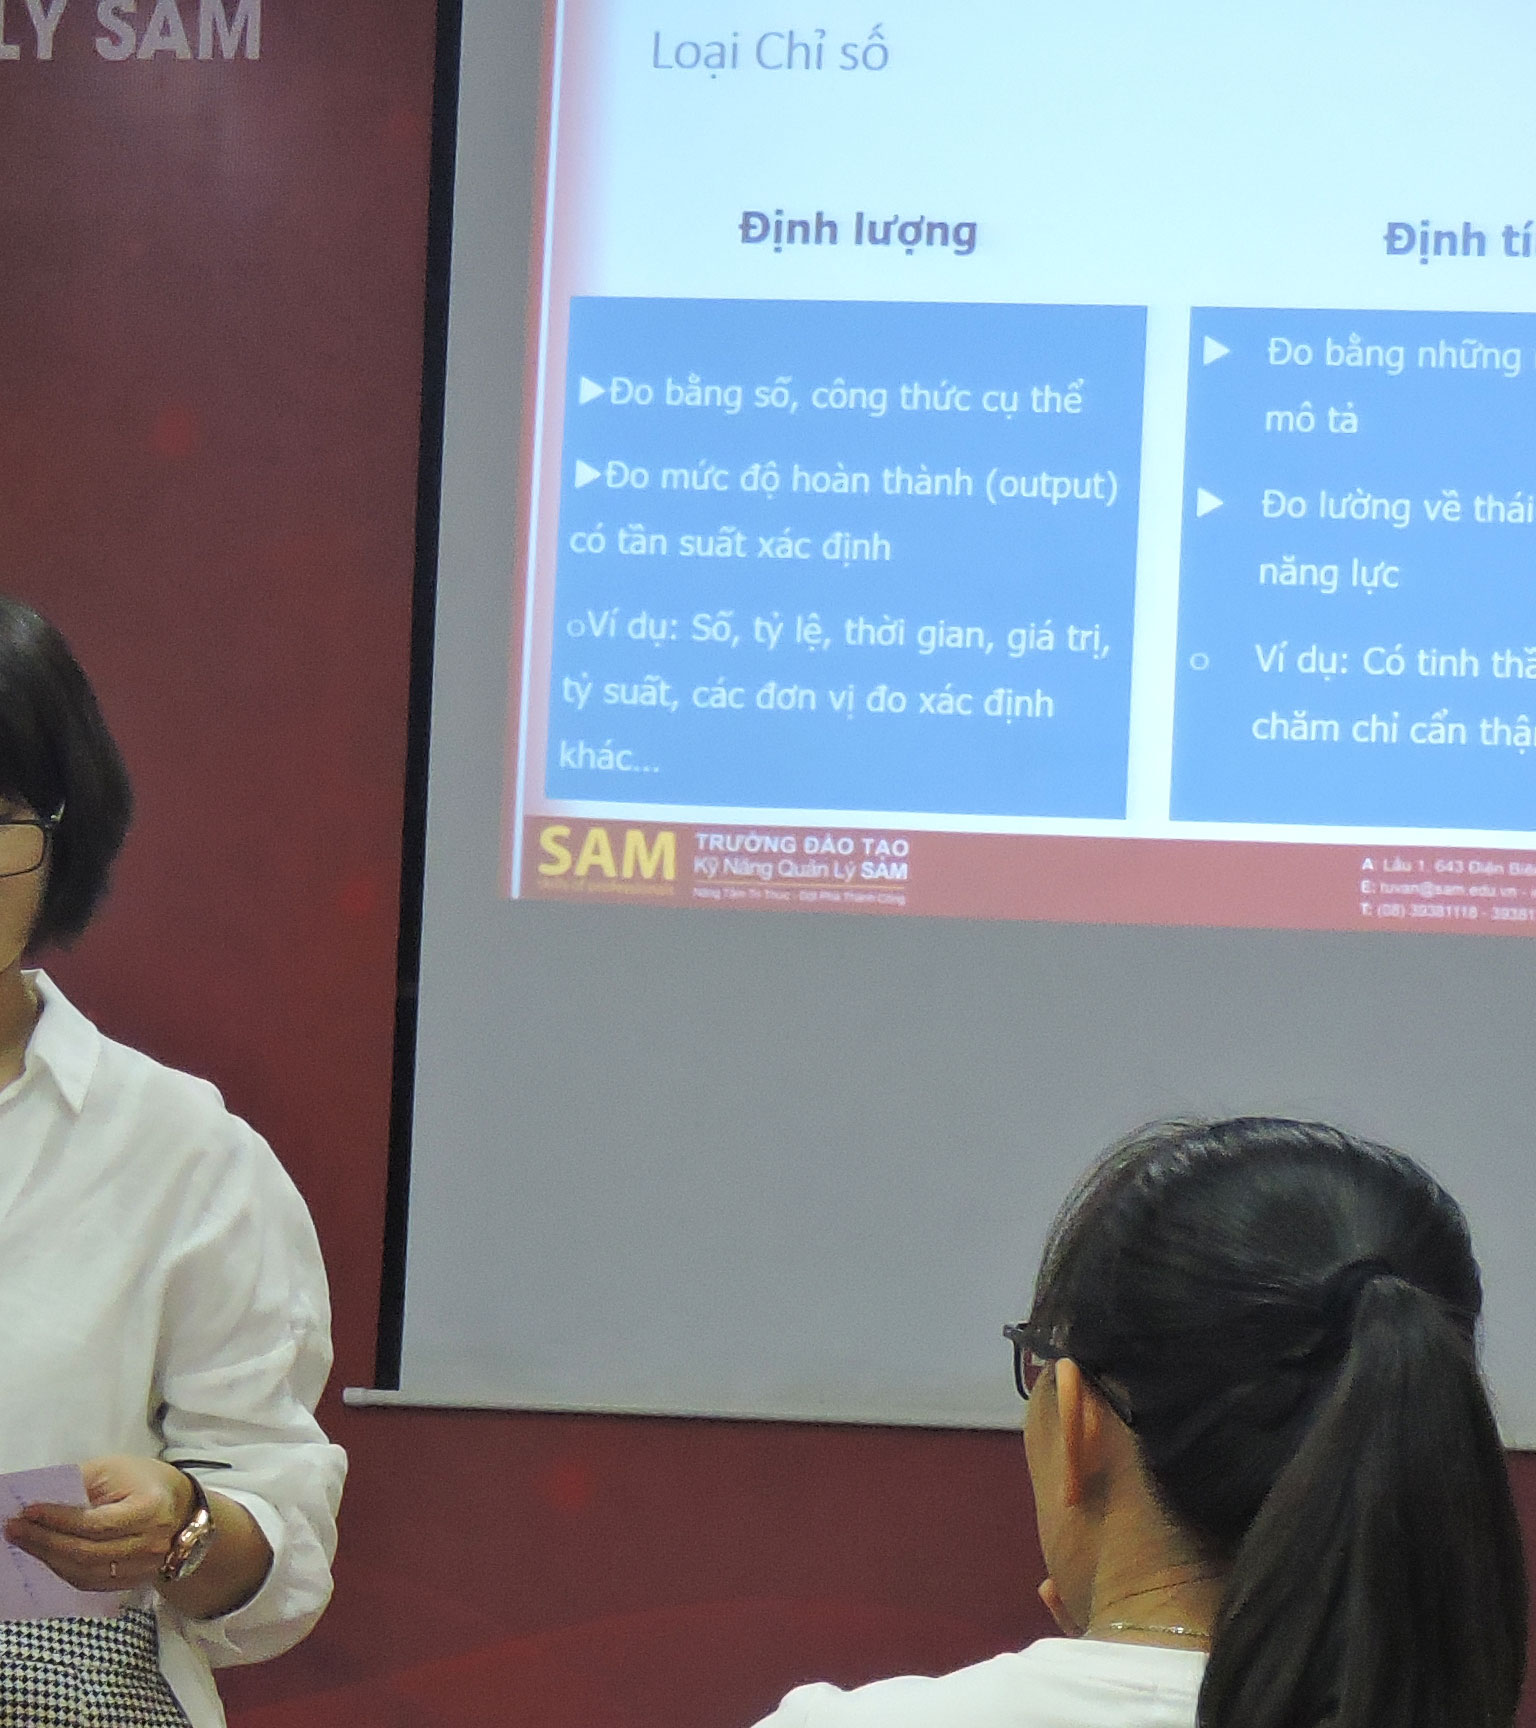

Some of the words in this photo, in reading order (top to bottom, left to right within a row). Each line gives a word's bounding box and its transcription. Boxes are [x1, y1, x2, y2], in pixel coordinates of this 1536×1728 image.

[94, 0, 261, 61] SAM
[652, 30, 739, 79] Loại
[755, 27, 826, 71] Chỉ
[840, 22, 891, 71] số
[739, 208, 839, 254] Định
[855, 210, 978, 255] lượng
[1383, 219, 1486, 265] Định
[1268, 336, 1314, 367] Đo
[1326, 331, 1404, 376] bằng
[1418, 338, 1522, 378] những
[609, 378, 654, 407] Đo
[665, 371, 743, 415] bằng
[754, 375, 798, 415] số,
[811, 379, 888, 418] công
[899, 378, 972, 413] thức
[982, 387, 1018, 419] cụ
[1030, 377, 1085, 415] thể
[1265, 400, 1315, 434] mô
[1327, 401, 1359, 434] tả
[604, 460, 650, 490] Đo
[661, 458, 729, 492] mức
[740, 462, 781, 499] độ
[792, 462, 870, 494] hoàn
[883, 464, 973, 497] thành
[985, 467, 1119, 507] (output)
[1262, 489, 1308, 520] Đo
[1319, 489, 1411, 529] lường
[1424, 488, 1462, 522] về
[1473, 491, 1534, 525] thái
[569, 523, 606, 554] có
[617, 523, 667, 557] tần
[679, 524, 747, 558] suất
[757, 527, 811, 560] xác
[821, 531, 892, 567] định
[1259, 555, 1339, 594] năng
[1351, 558, 1400, 597] lực
[586, 606, 620, 639] Ví
[627, 609, 679, 647] dụ:
[691, 609, 740, 649] Số,
[753, 612, 785, 649] tỷ
[795, 612, 832, 653] lệ,
[844, 615, 906, 648] thời
[917, 618, 994, 656] gian,
[1007, 620, 1055, 658] giá
[1066, 623, 1111, 661] trị,
[1255, 640, 1287, 674] Ví
[1296, 645, 1349, 683] dụ:
[1362, 644, 1406, 677] Có
[1417, 646, 1479, 679] tinh
[562, 674, 593, 710] tỷ
[603, 674, 680, 714] suất,
[692, 677, 744, 710] các
[756, 679, 817, 712] đơn
[829, 683, 856, 721] vị
[866, 684, 907, 715] đo
[918, 683, 973, 717] xác
[983, 686, 1055, 724] định
[1252, 710, 1340, 743] chăm
[1409, 707, 1466, 746] cẩn
[559, 739, 661, 775] khác...
[538, 825, 677, 880] SAM
[695, 831, 797, 854] TRƯỜNG
[803, 833, 855, 856] ĐÀO
[861, 837, 910, 861] TẠO
[860, 861, 909, 881] SAM
